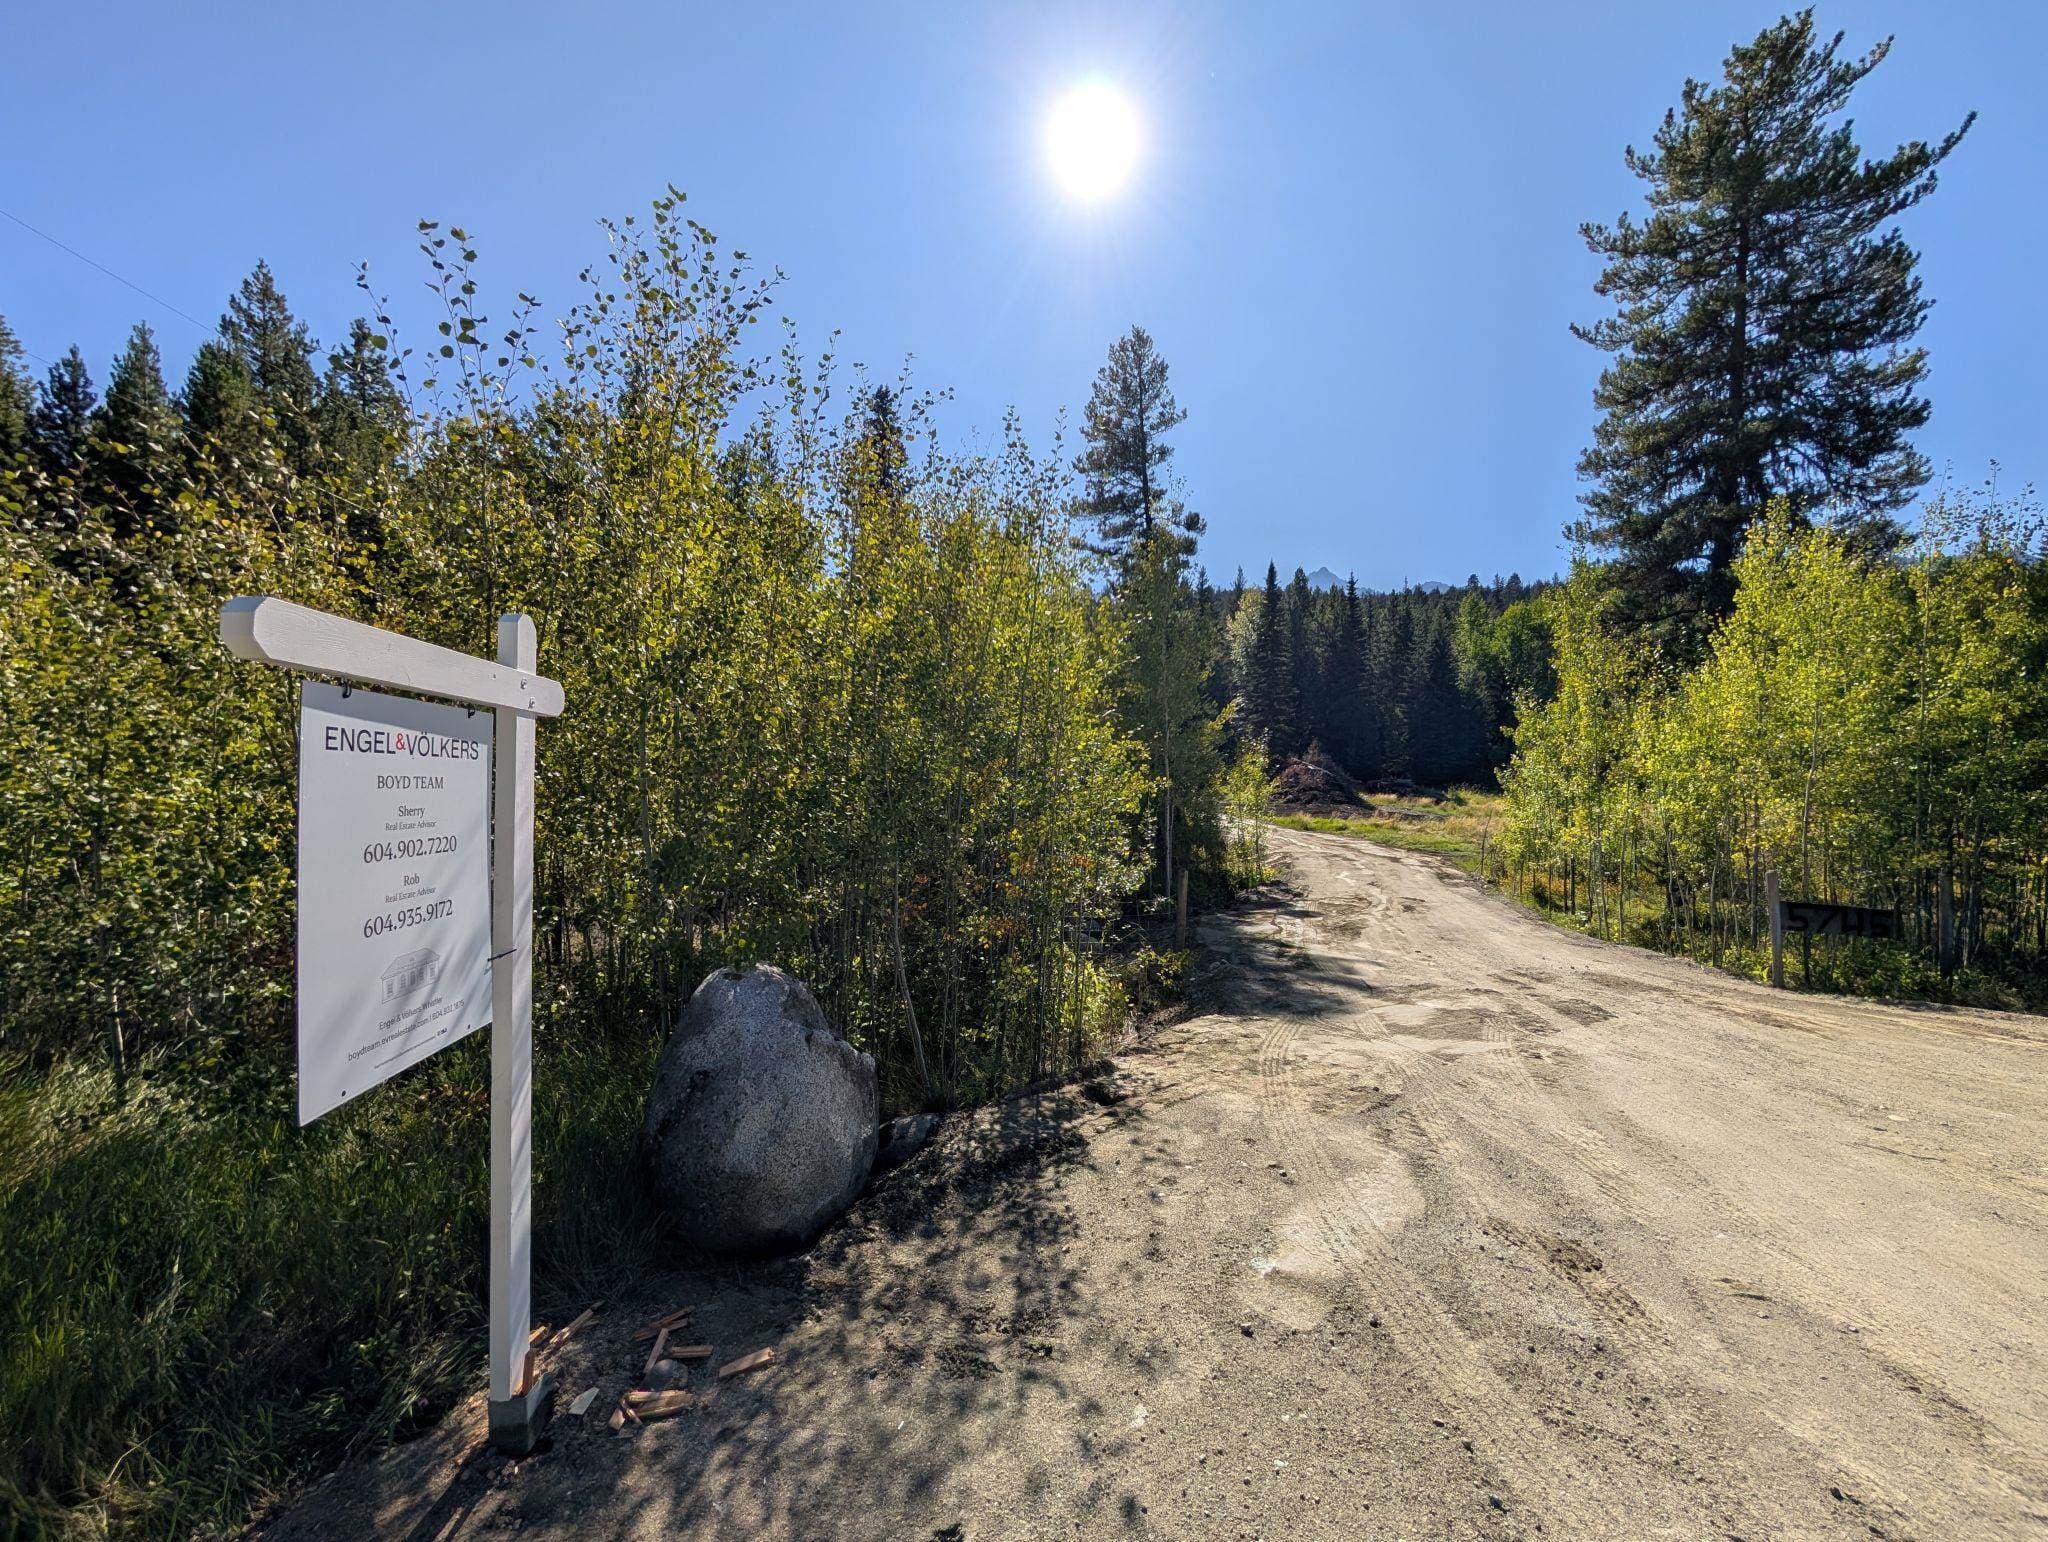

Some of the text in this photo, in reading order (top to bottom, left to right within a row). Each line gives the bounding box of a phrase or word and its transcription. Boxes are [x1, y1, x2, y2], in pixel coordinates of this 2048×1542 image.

[377, 775, 444, 790] BOYD TEAM
[397, 805, 426, 819] Sherry
[385, 820, 437, 832] Real Estate Advisor
[363, 835, 458, 864] 604.902.7220
[403, 873, 420, 887] Rob
[385, 886, 437, 904] Real Estate Advisor
[363, 899, 453, 938] 604.935.9172
